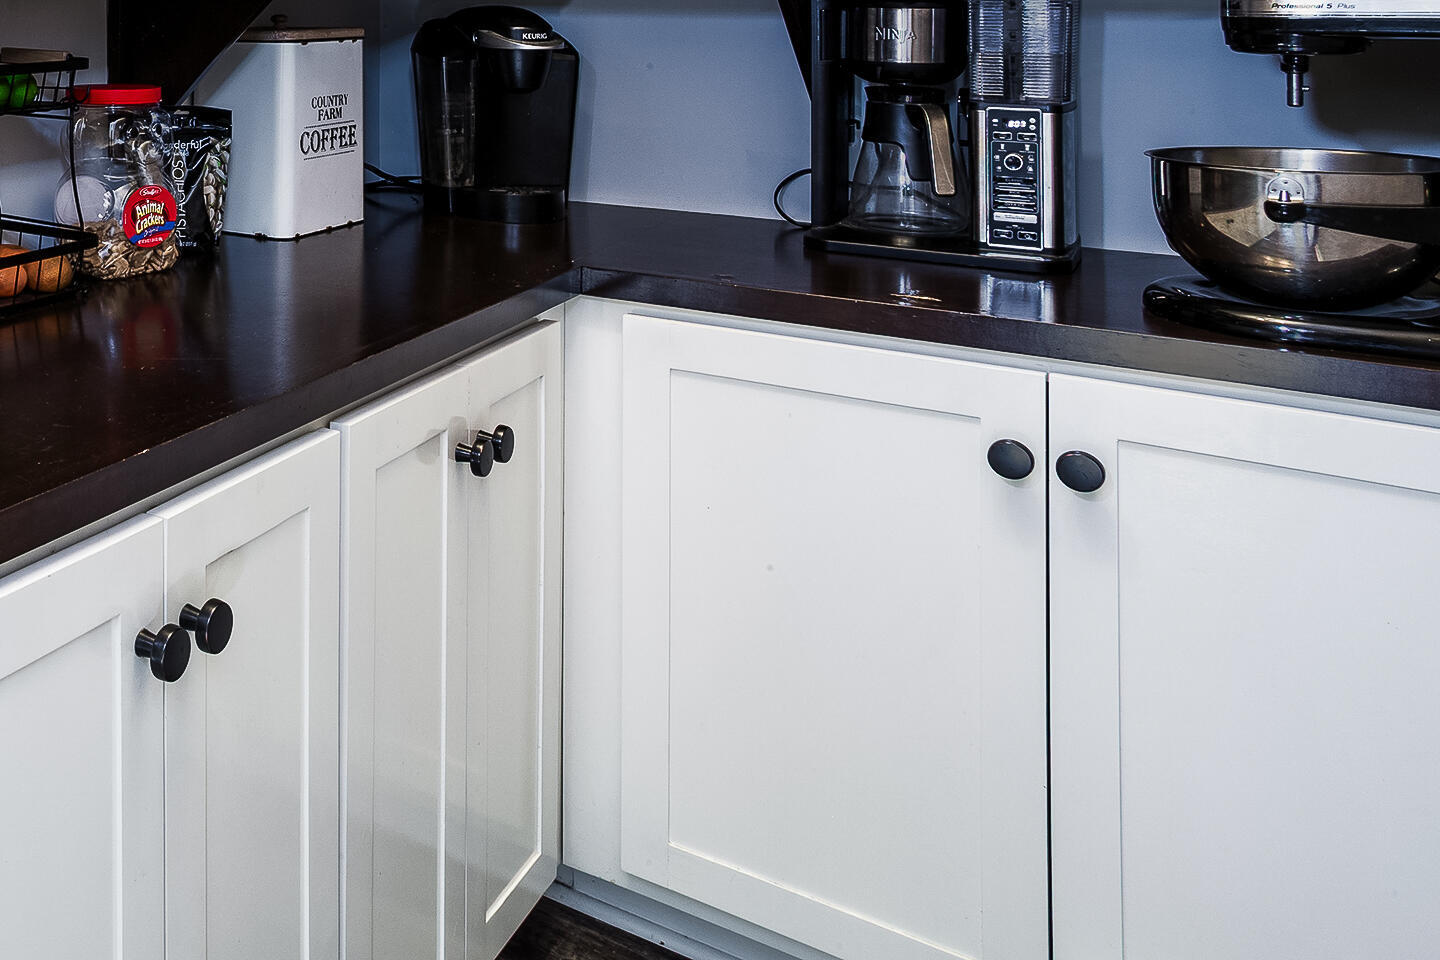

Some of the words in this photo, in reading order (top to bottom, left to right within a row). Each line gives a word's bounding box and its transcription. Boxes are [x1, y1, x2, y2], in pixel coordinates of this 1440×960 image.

[875, 26, 917, 44] NINJA
[310, 93, 349, 110] COUNTRY
[318, 107, 343, 121] FARM
[300, 125, 358, 155] COFFEE
[136, 199, 164, 218] Animal
[136, 213, 165, 234] Crackers
